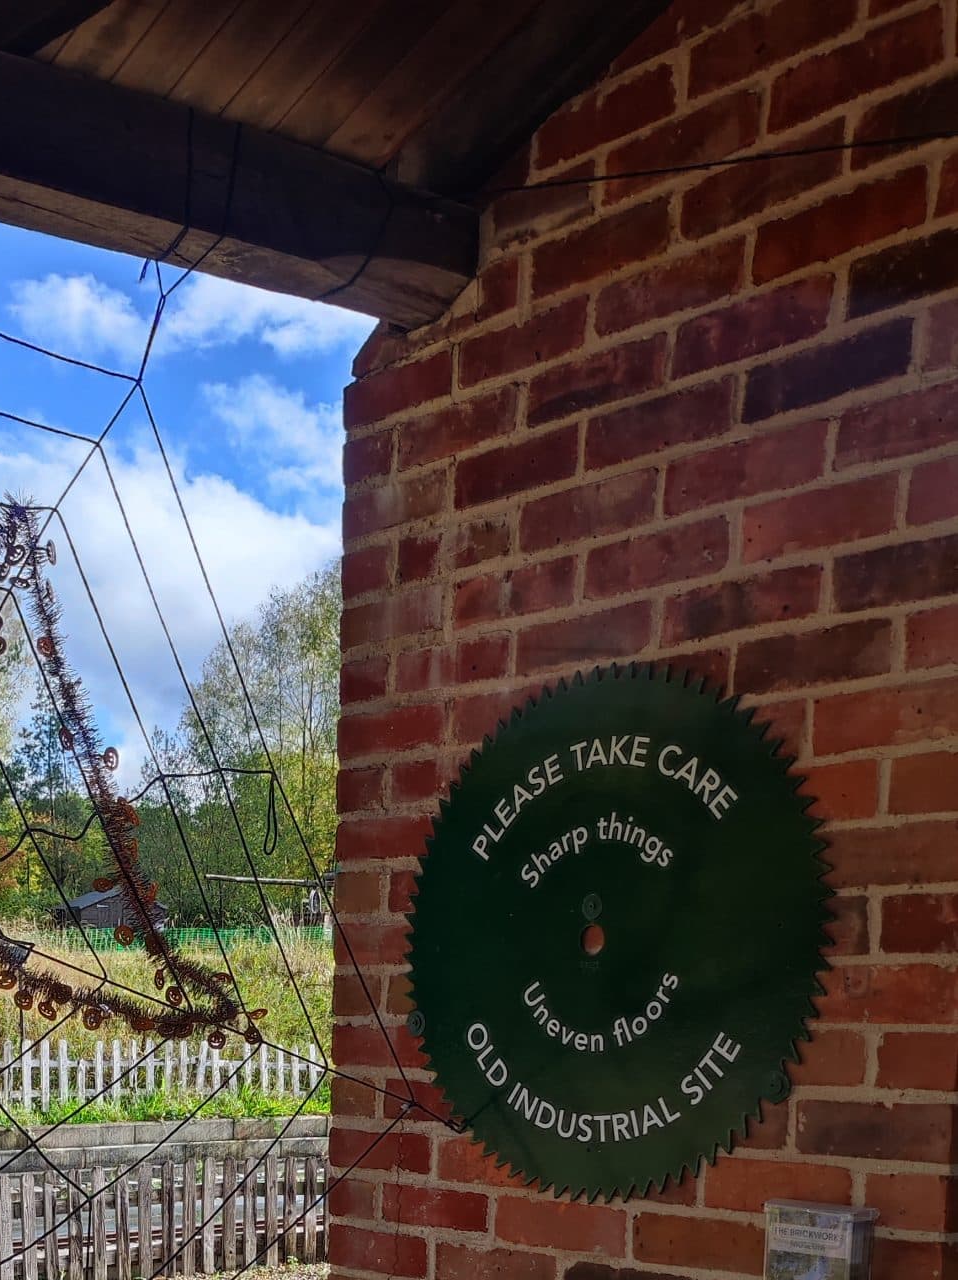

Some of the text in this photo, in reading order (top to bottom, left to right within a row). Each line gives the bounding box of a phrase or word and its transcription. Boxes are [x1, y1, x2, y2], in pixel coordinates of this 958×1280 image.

[472, 735, 738, 860] PLEASE TAKE CARE
[520, 811, 674, 888] Sharp things
[523, 972, 679, 1053] Uneven floors
[467, 1022, 741, 1142] OLD INDUSTRIAL SITE
